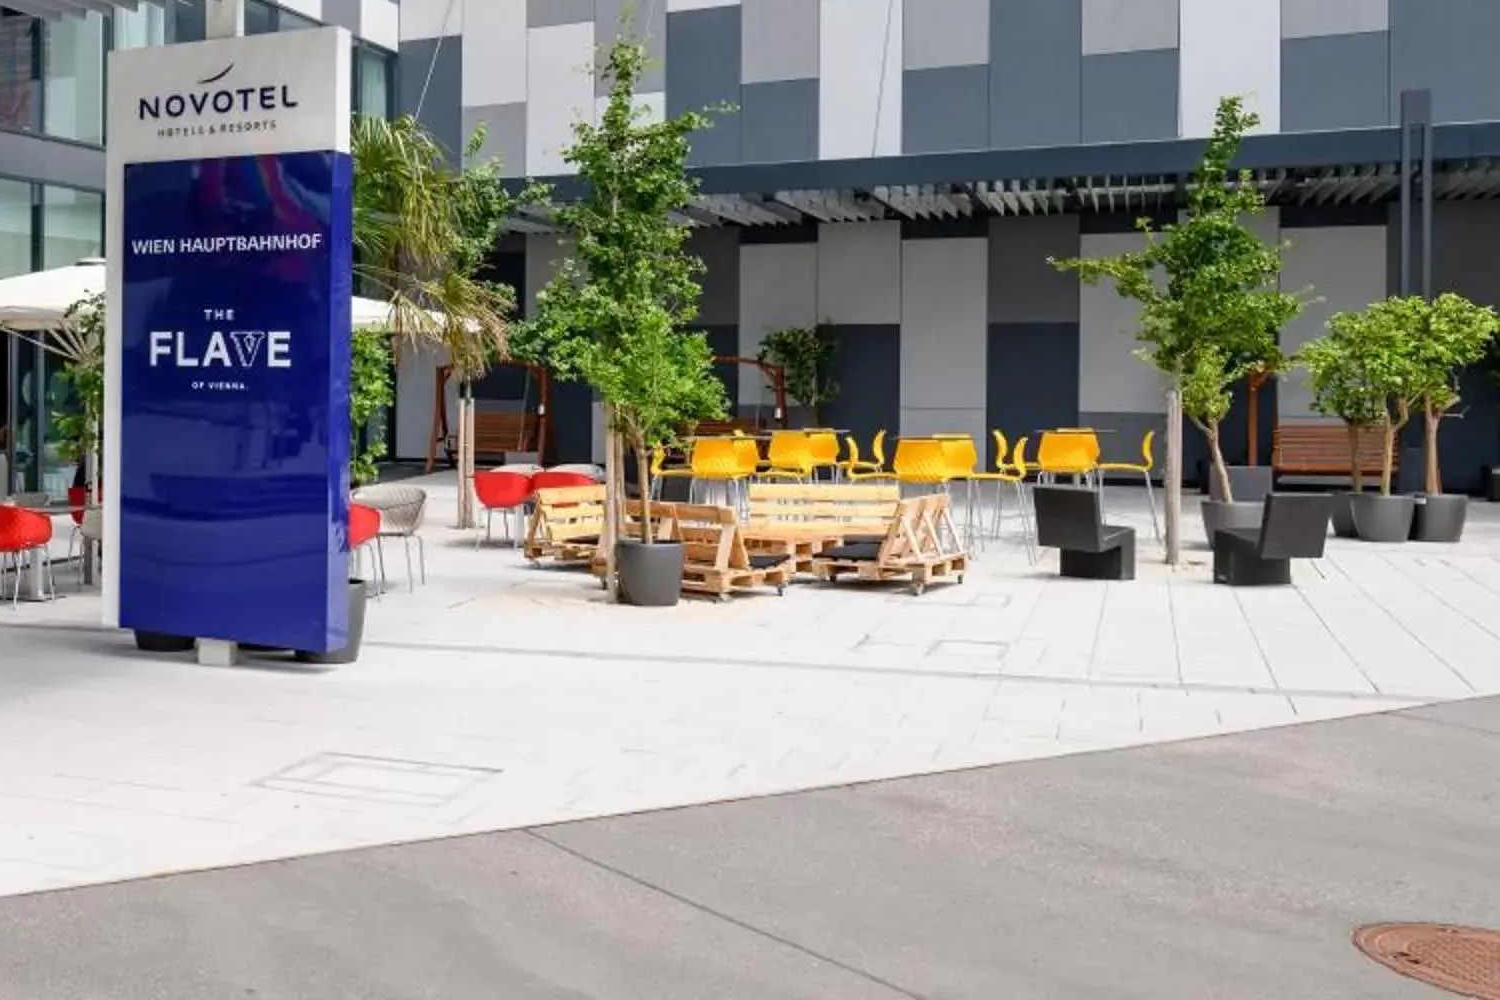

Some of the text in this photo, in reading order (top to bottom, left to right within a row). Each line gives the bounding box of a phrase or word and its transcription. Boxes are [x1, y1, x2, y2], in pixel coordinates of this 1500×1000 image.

[139, 85, 298, 120] NOVOTEL
[132, 233, 322, 255] WIEN HAUPTBAHNHOF
[204, 309, 234, 321] THE
[150, 331, 291, 367] FLAVE
